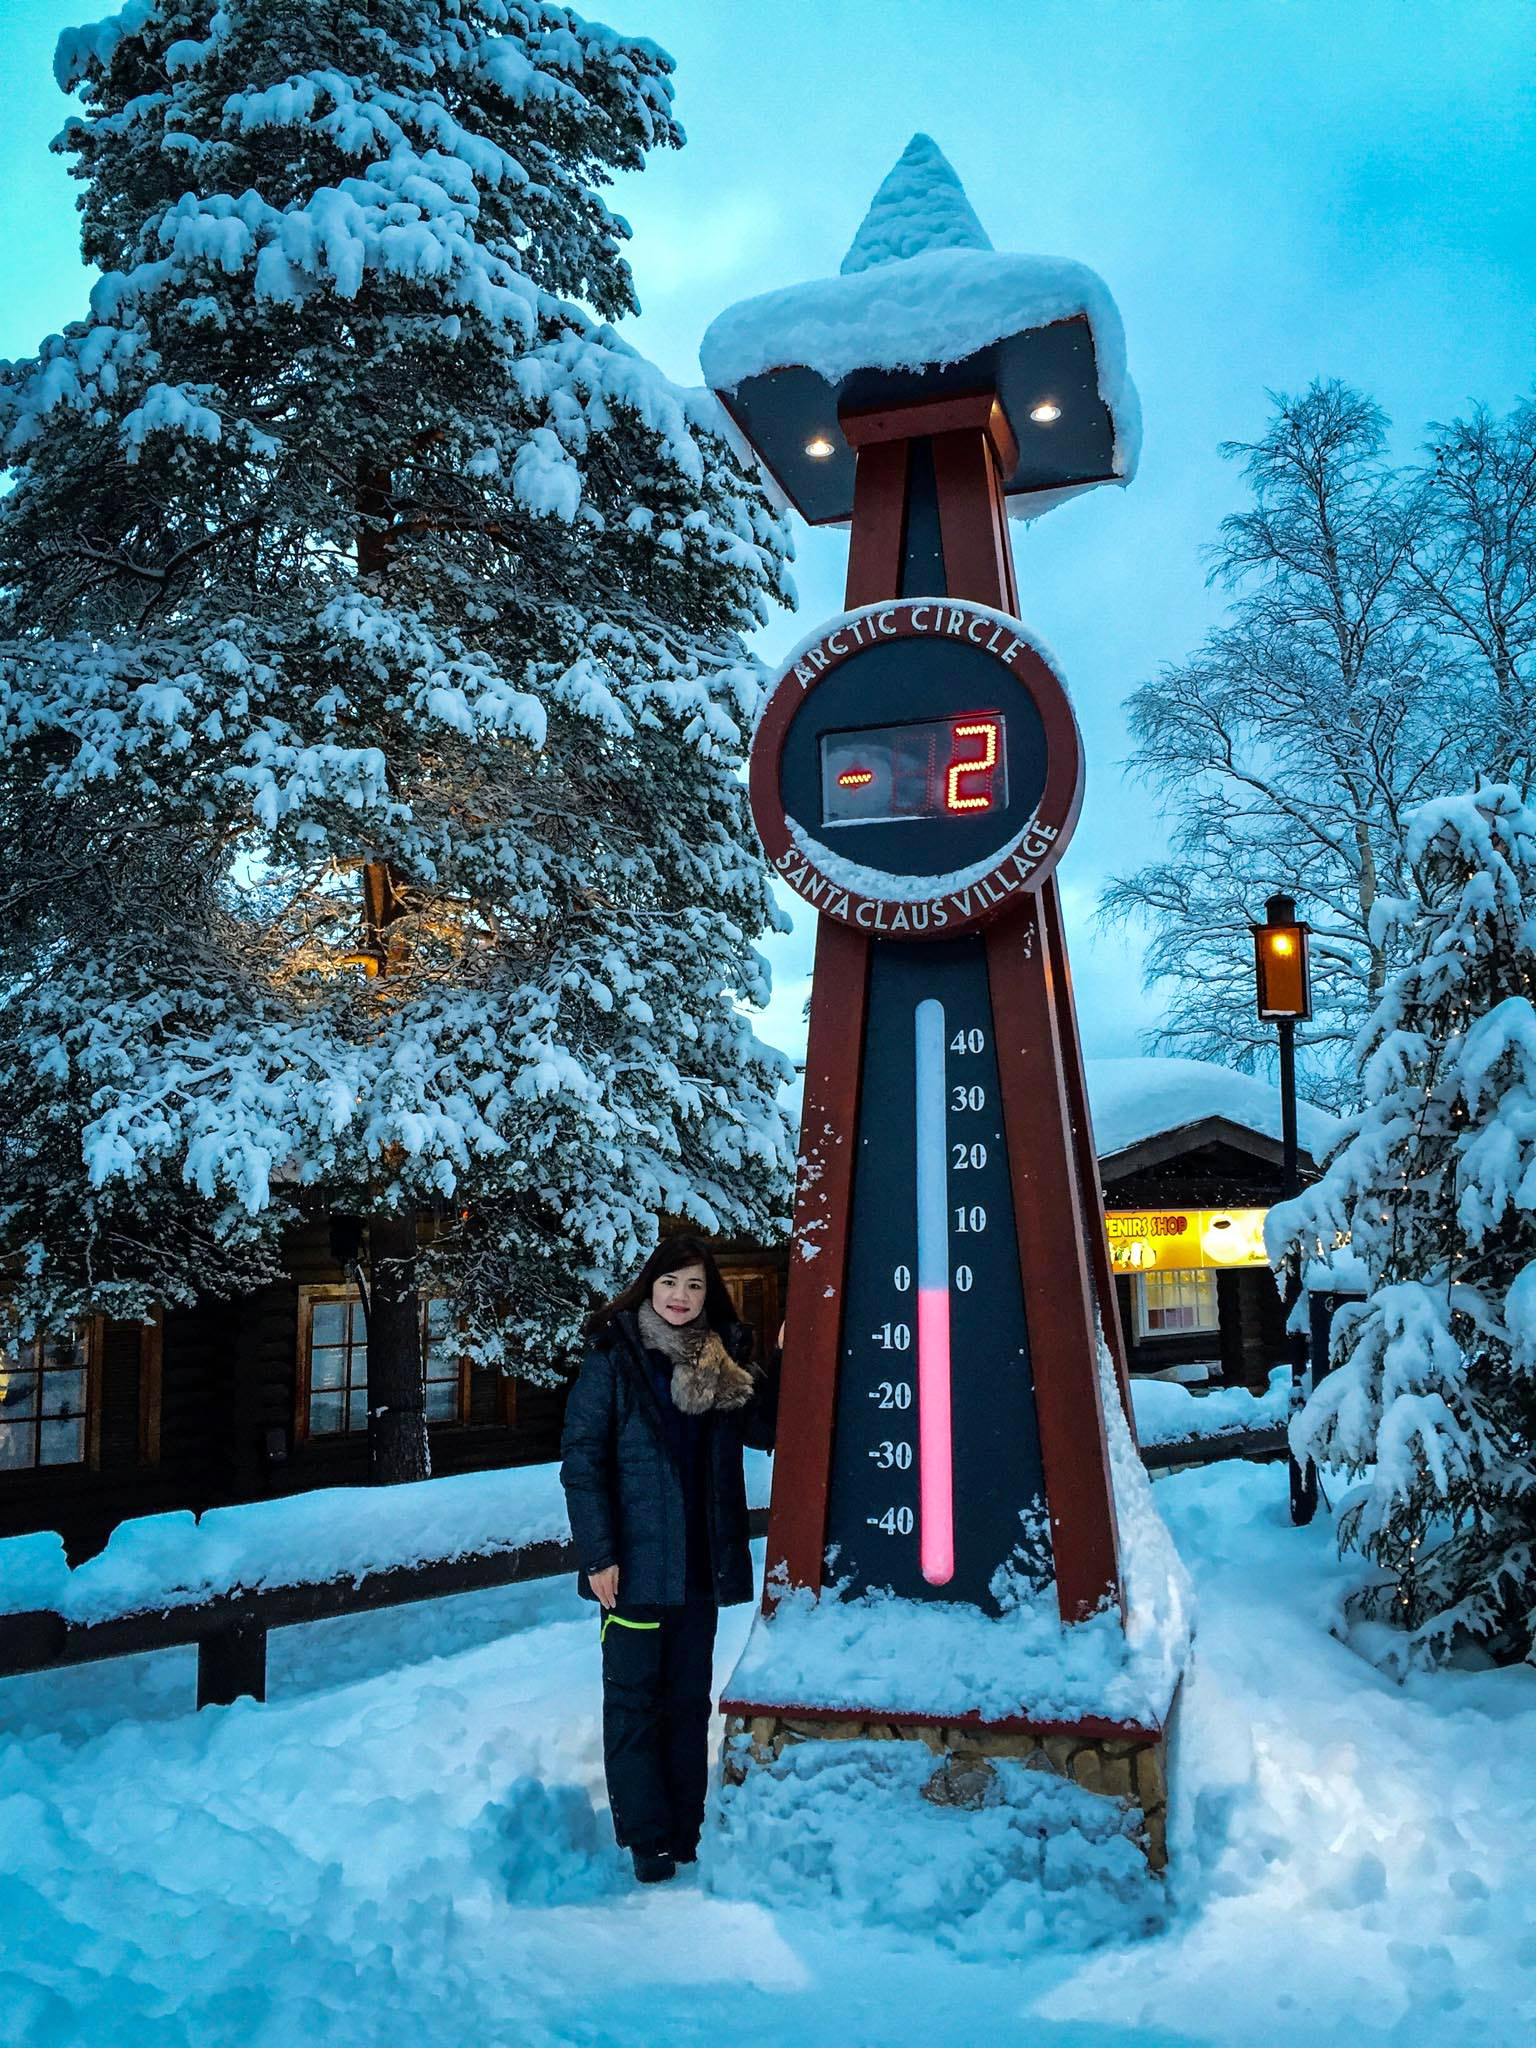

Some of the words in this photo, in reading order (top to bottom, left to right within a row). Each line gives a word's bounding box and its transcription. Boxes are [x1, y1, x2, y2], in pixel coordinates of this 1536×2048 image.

[793, 609, 897, 690] ARCTIC
[911, 606, 1026, 664] CIRCLE
[775, 847, 849, 922] SANTA
[855, 900, 949, 931] CLAUS
[951, 819, 1060, 918] VILLAGE
[949, 1028, 985, 1055] 40
[950, 1085, 986, 1112] 30
[951, 1143, 988, 1170] 20
[954, 1206, 987, 1233] 10
[1104, 1217, 1148, 1237] ENIRS
[1151, 1216, 1187, 1236] SHOP
[893, 1265, 911, 1292] 0
[955, 1265, 973, 1292] 0
[871, 1323, 911, 1351] -10
[868, 1381, 912, 1410] -20
[868, 1441, 913, 1470] -30
[866, 1506, 914, 1536] -40
